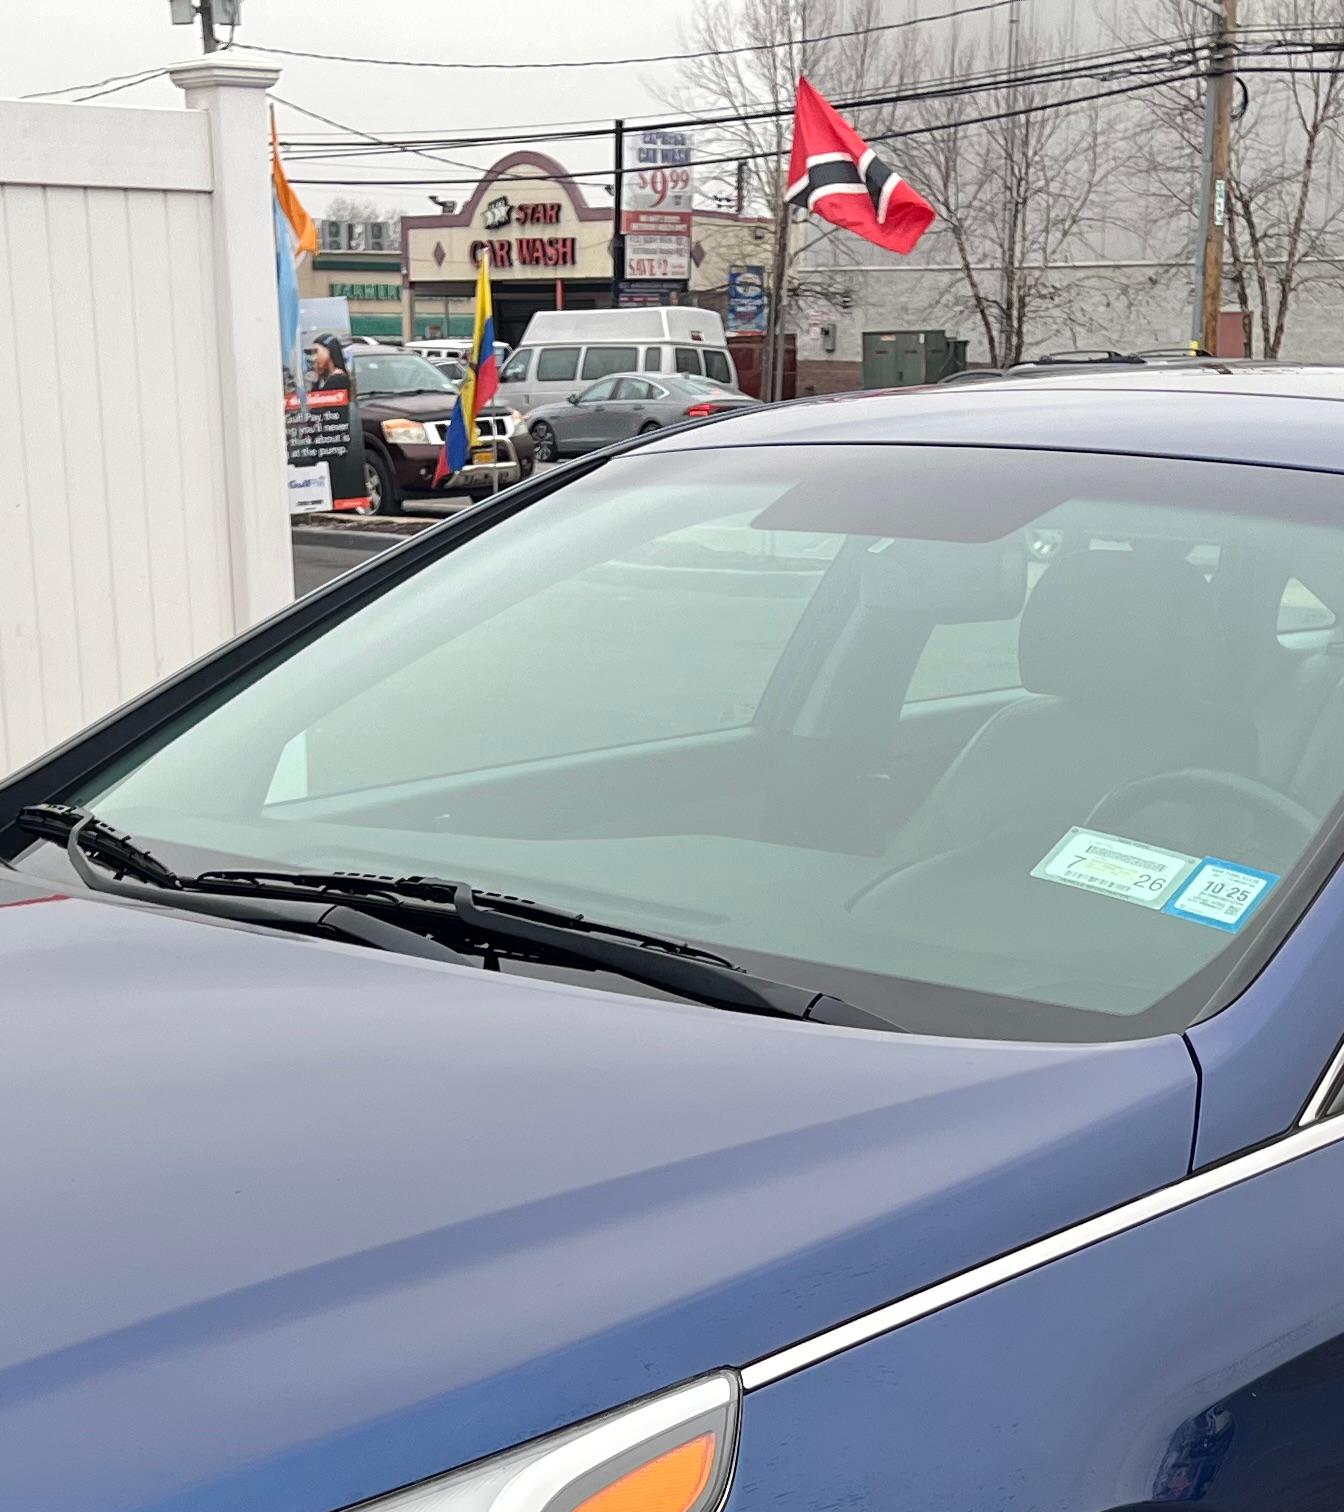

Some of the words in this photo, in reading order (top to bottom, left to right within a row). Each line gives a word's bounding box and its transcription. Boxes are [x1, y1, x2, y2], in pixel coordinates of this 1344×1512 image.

[516, 203, 561, 225] STAR
[470, 239, 513, 268] CAR
[515, 237, 576, 266] WASH
[1067, 855, 1087, 868] 7
[1133, 874, 1167, 892] 26
[1204, 880, 1226, 894] 10
[1227, 887, 1250, 902] 25
